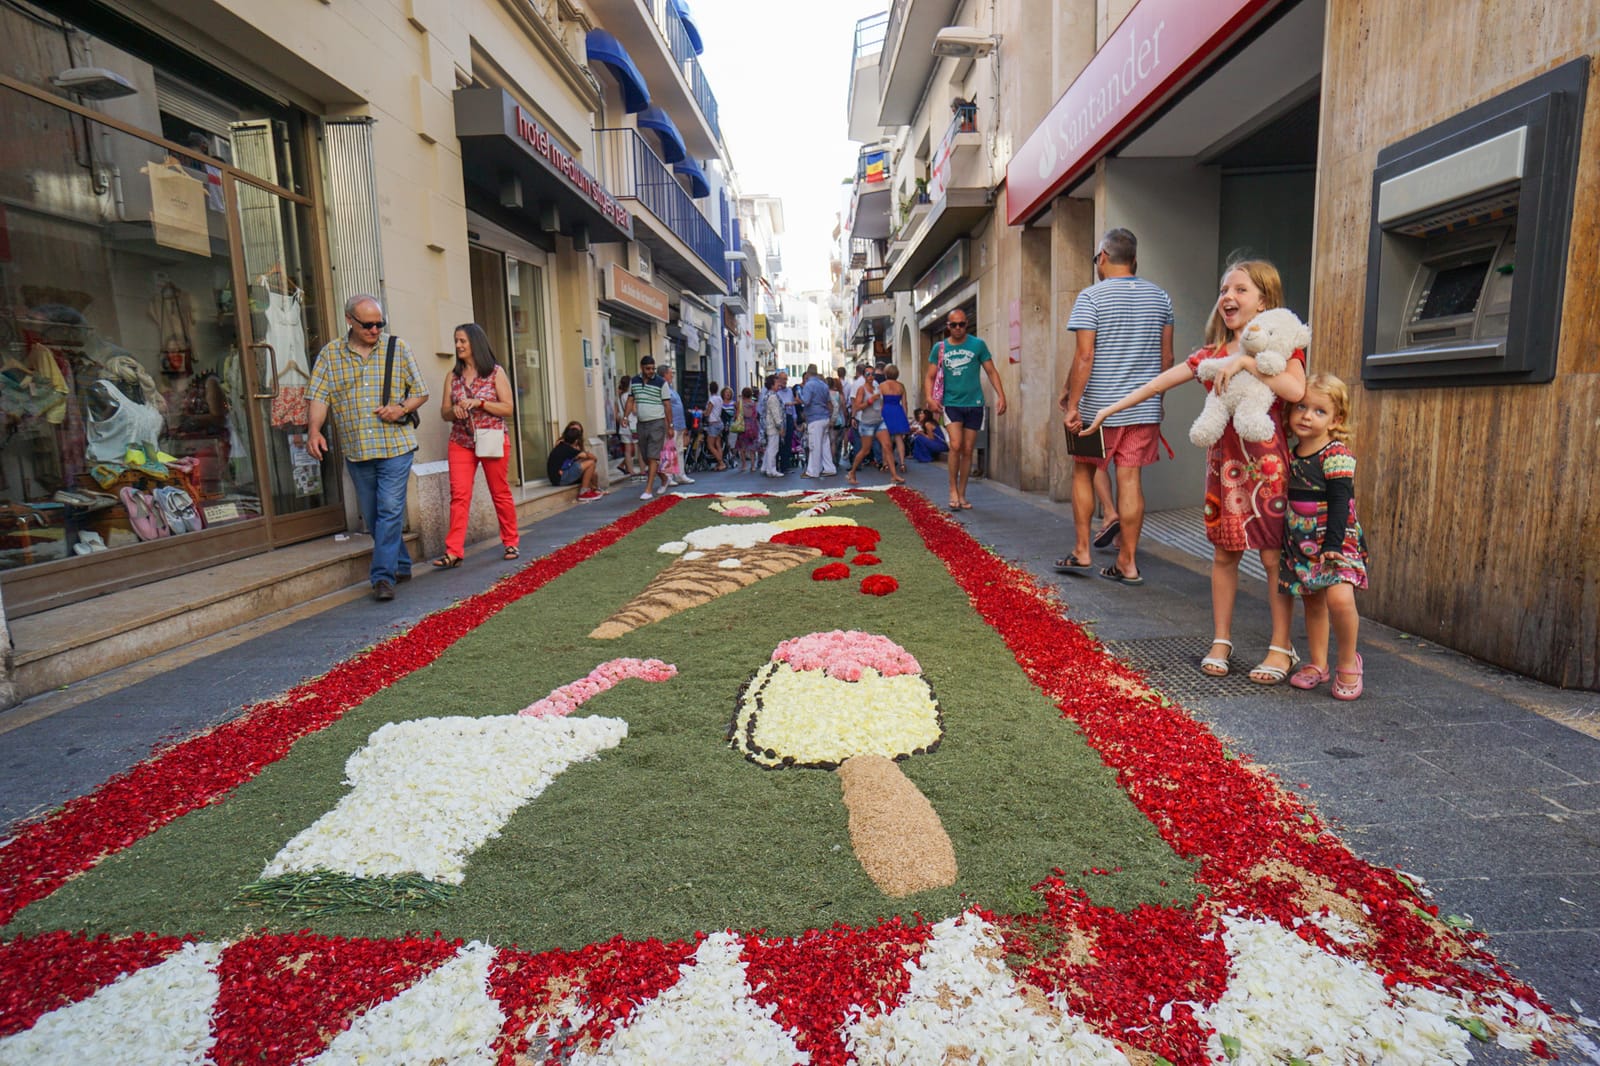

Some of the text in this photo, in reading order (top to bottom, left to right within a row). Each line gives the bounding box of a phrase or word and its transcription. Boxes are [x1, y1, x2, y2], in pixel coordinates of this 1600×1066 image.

[1059, 19, 1165, 161] Santander
[516, 105, 550, 159] hotel
[551, 143, 591, 196] medium
[591, 179, 615, 216] sitges
